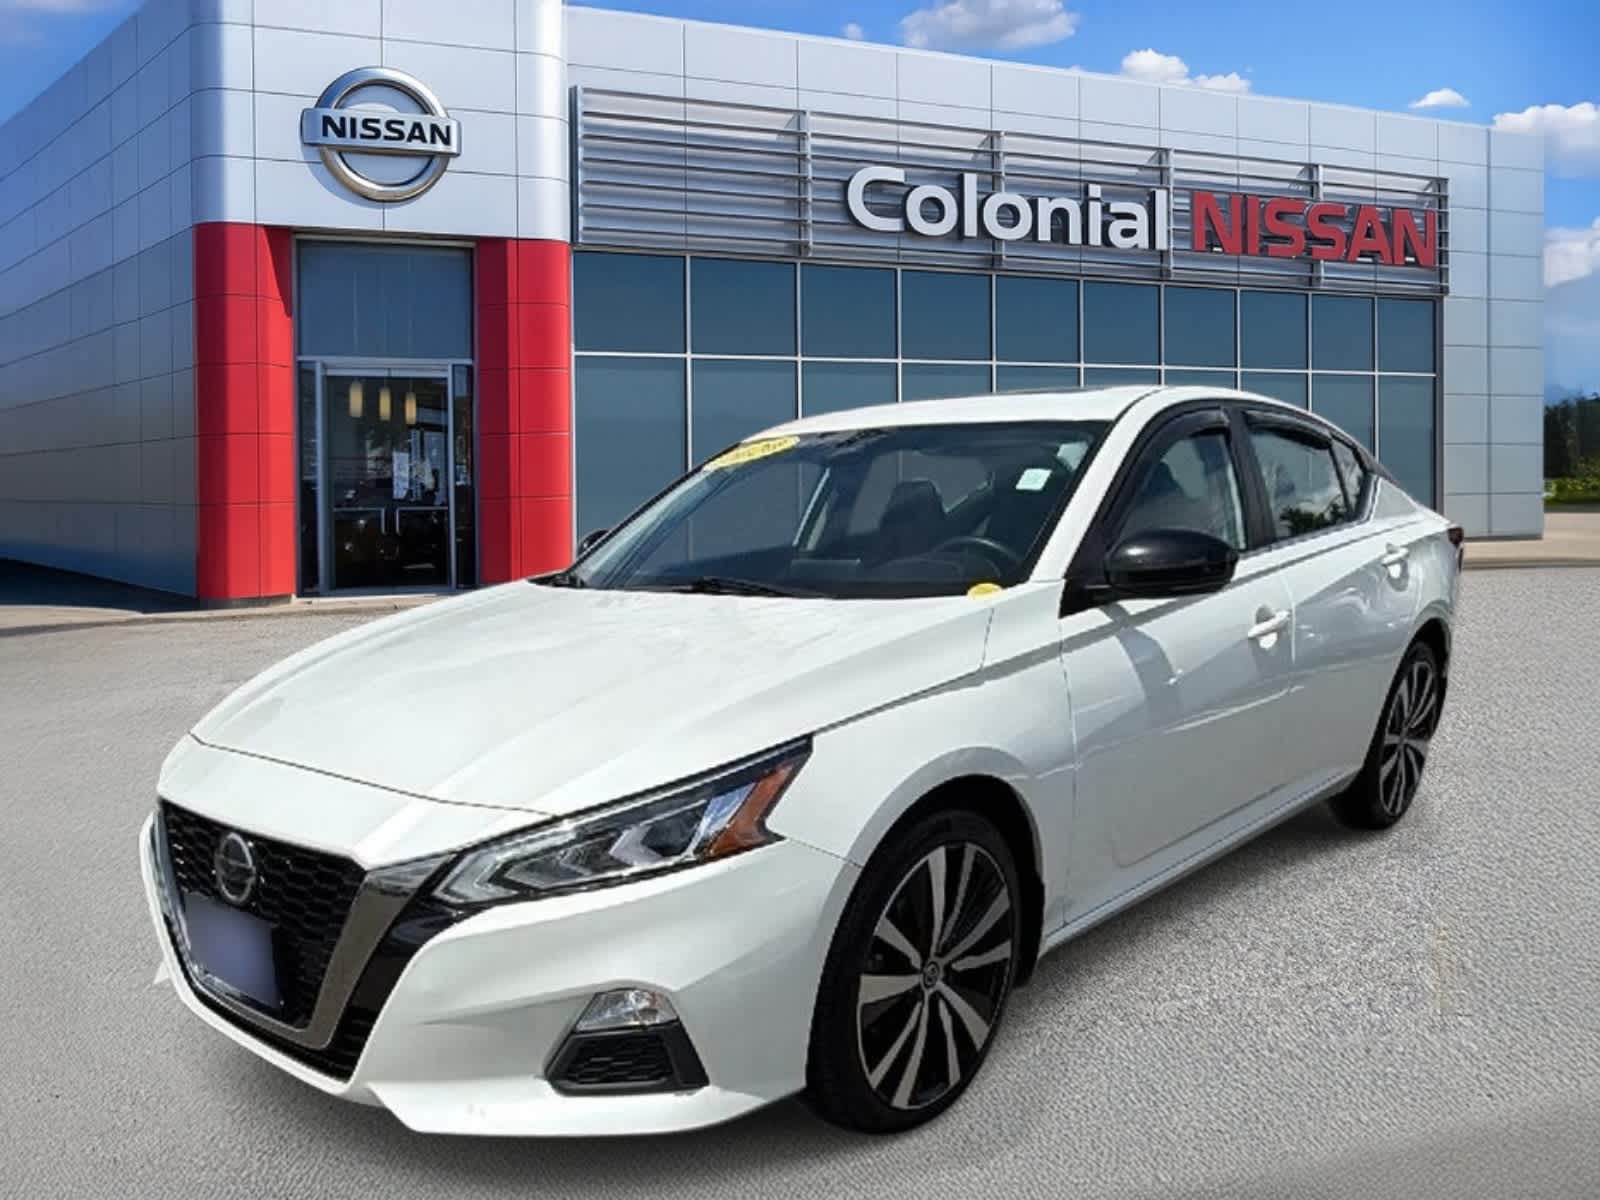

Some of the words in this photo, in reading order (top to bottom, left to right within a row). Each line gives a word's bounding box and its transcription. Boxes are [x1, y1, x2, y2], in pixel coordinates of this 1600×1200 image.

[321, 115, 452, 146] NISSAN
[847, 166, 1168, 250] Colonial
[1191, 190, 1436, 268] NISSAN
